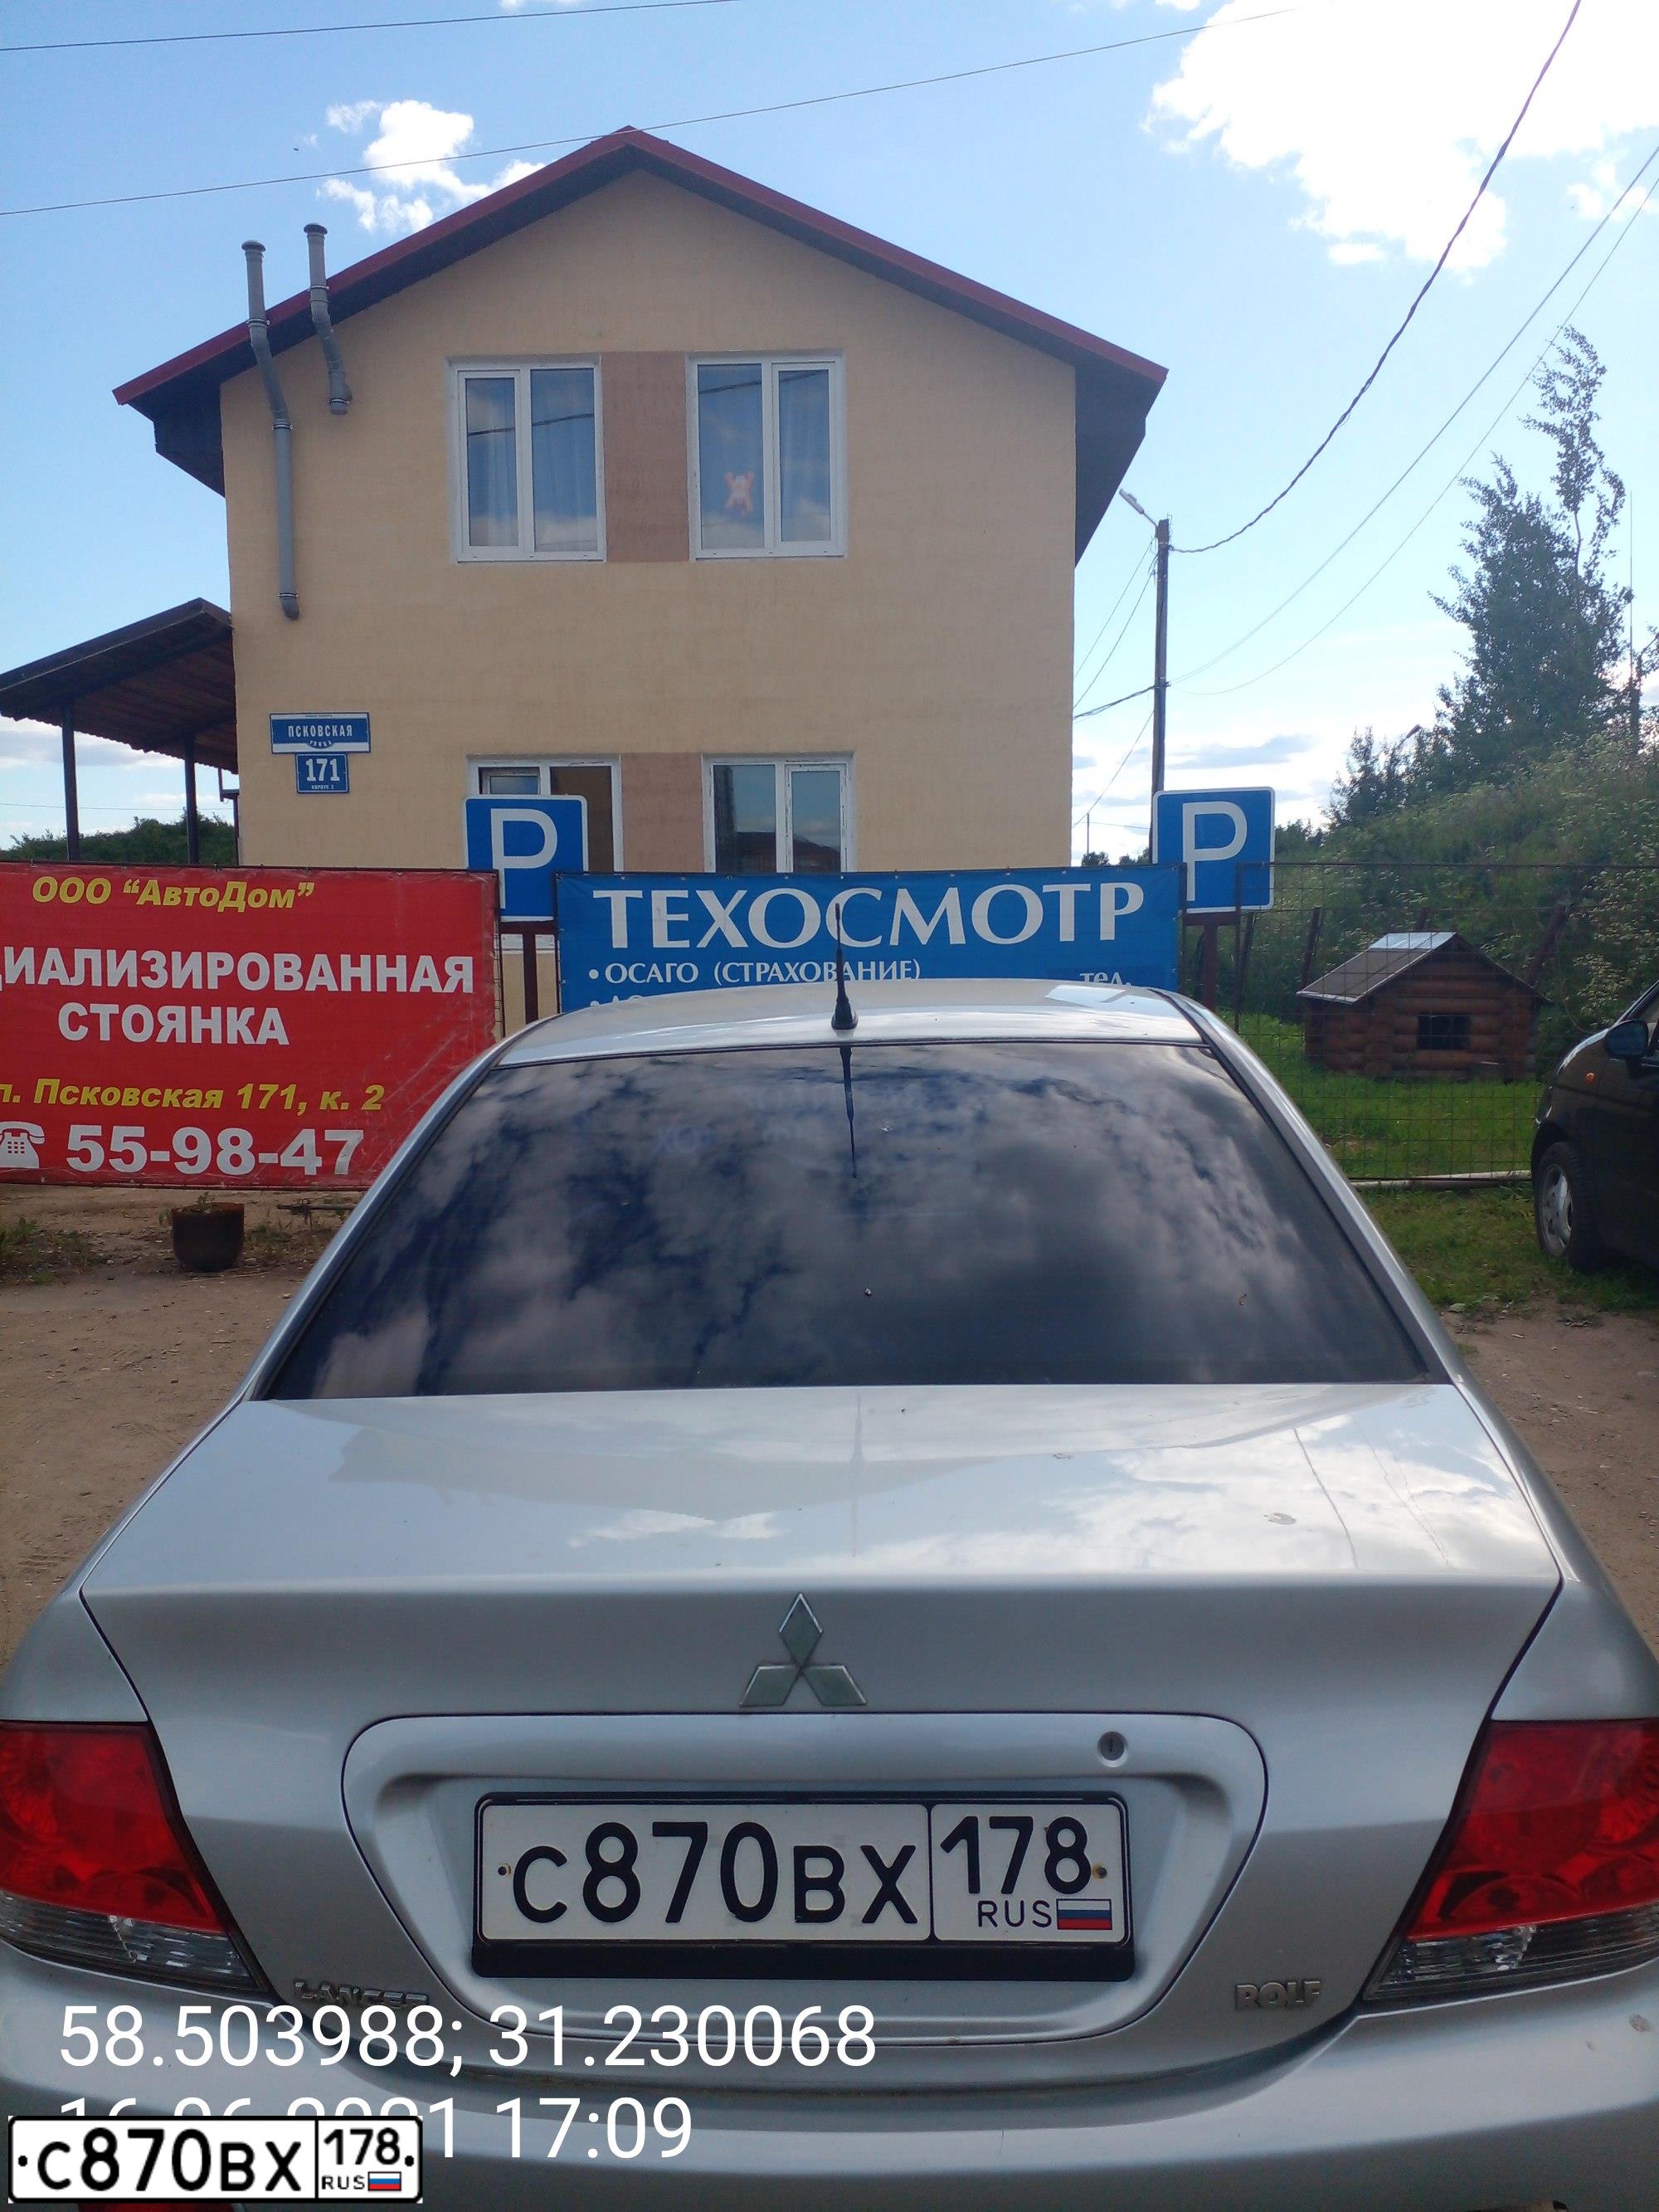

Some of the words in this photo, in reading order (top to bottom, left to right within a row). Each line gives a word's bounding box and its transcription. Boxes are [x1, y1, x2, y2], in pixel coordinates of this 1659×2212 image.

[288, 724, 353, 738] ПСКОВСКАЯ
[305, 758, 341, 782] 171
[32, 876, 111, 905] ООО
[592, 881, 1144, 949] ТЕХОСМОТР
[0, 946, 474, 993] ИАЛИЗИРОВАННАЯ
[605, 962, 699, 984] ОСАГО
[57, 1002, 289, 1045] СТОЯНКА
[33, 1078, 223, 1109] Псковская
[319, 1091, 349, 1111] к.
[360, 1084, 386, 1111] 2
[66, 1123, 365, 1176] 55-98-47
[940, 1815, 1092, 1895] 178
[977, 1899, 1053, 1929] RUS
